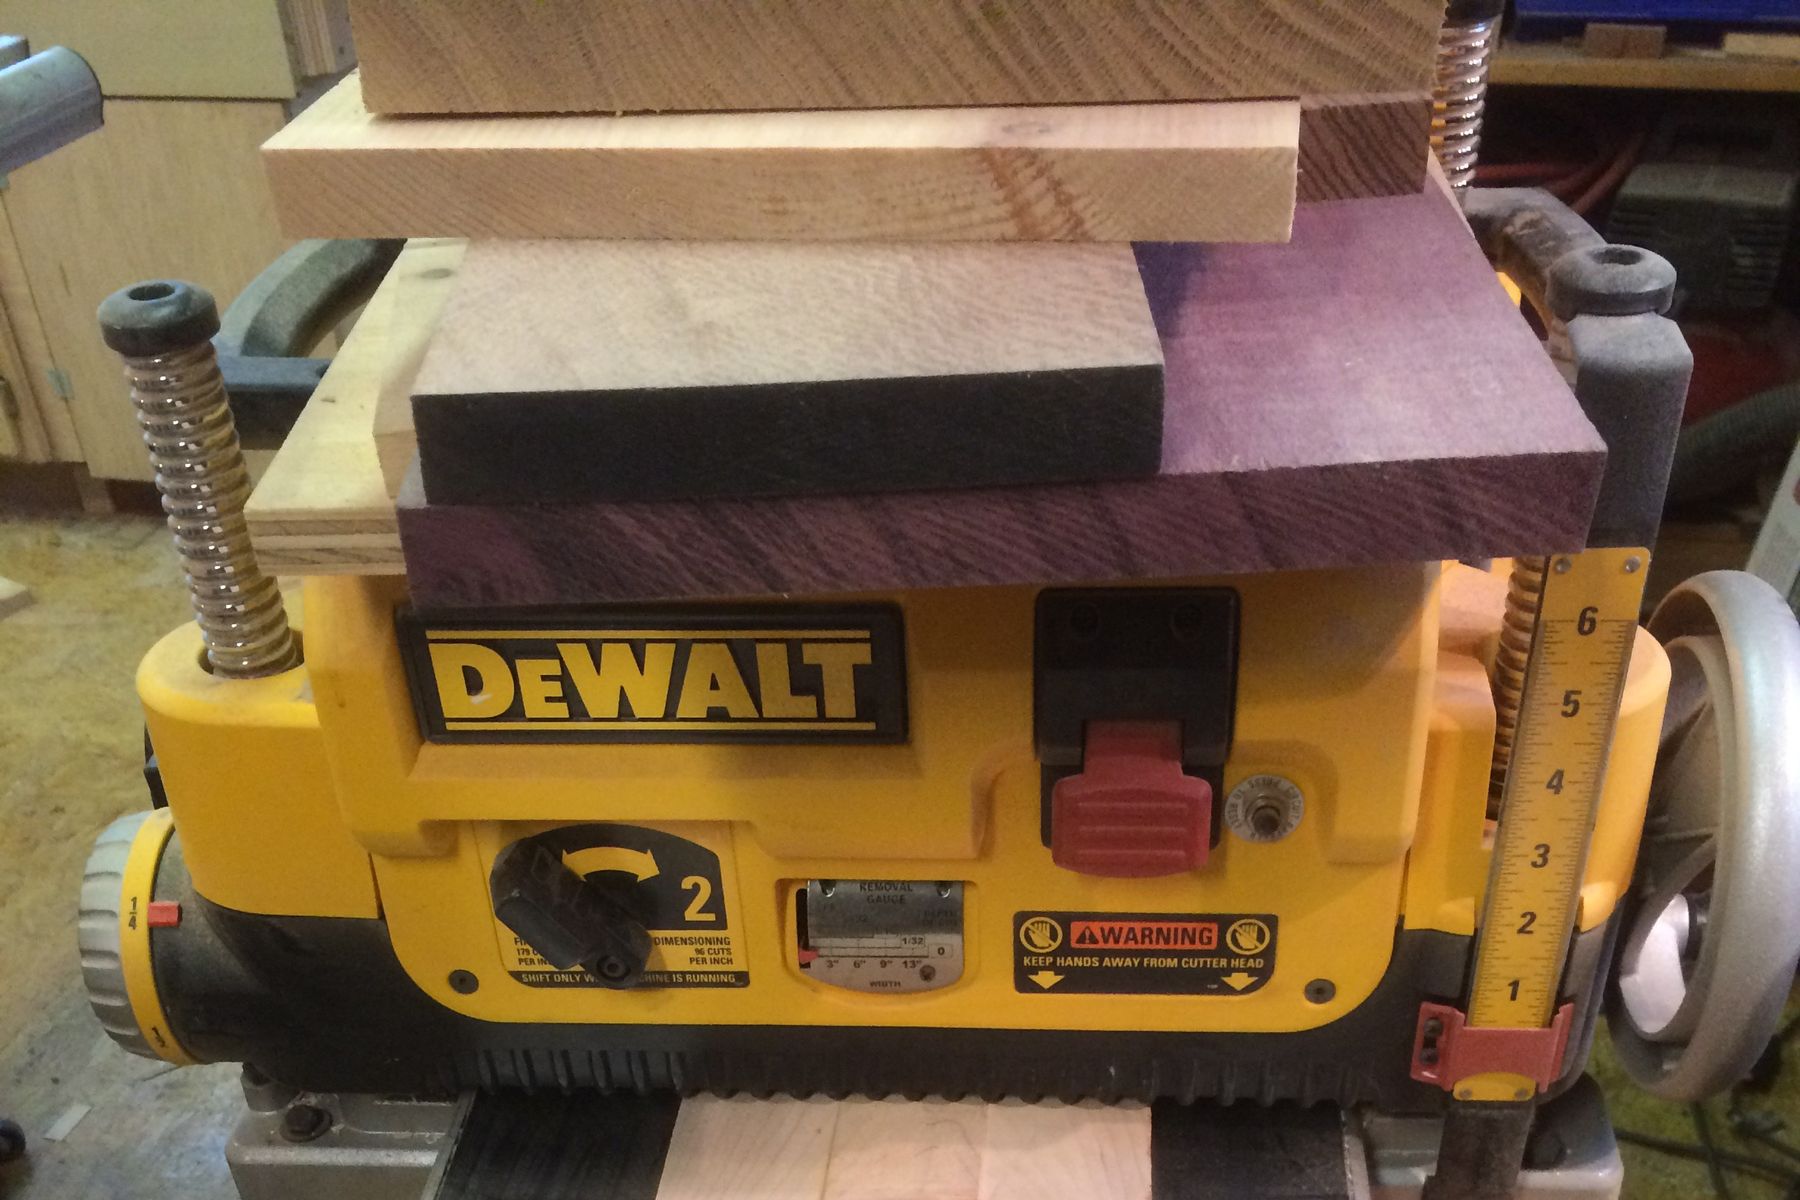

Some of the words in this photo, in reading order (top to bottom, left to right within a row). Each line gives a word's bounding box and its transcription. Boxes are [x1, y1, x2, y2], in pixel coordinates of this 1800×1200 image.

[1577, 606, 1599, 636] 6
[1561, 689, 1582, 718] 5
[1546, 768, 1565, 795] 4
[1531, 843, 1550, 869] 3
[859, 882, 913, 892] REMOVAL
[681, 876, 717, 921] 2
[866, 894, 907, 904] GAUGE
[1517, 911, 1537, 936] 2
[653, 936, 731, 946] DIMENSIONING
[902, 937, 924, 945] 1/32
[1099, 926, 1213, 946] WARNING
[694, 947, 705, 956] 96
[707, 947, 732, 956] CUTS
[937, 946, 945, 956] 0
[518, 957, 535, 966] PER
[689, 957, 707, 966] PER
[709, 957, 734, 966] INCH
[902, 959, 922, 969] 13"
[1023, 956, 1053, 967] KEEP
[1056, 956, 1100, 967] HANDS
[1102, 957, 1140, 968] AWAY
[1143, 957, 1178, 968] FROM
[1181, 957, 1228, 969] CUTTER
[1230, 958, 1264, 969] HEAD
[521, 973, 551, 983] SHIFT
[553, 973, 581, 983] ONLY
[672, 973, 684, 983] IS
[685, 973, 736, 983] RUNNING
[869, 980, 902, 988] WIDTH
[1507, 979, 1521, 1001] 1
